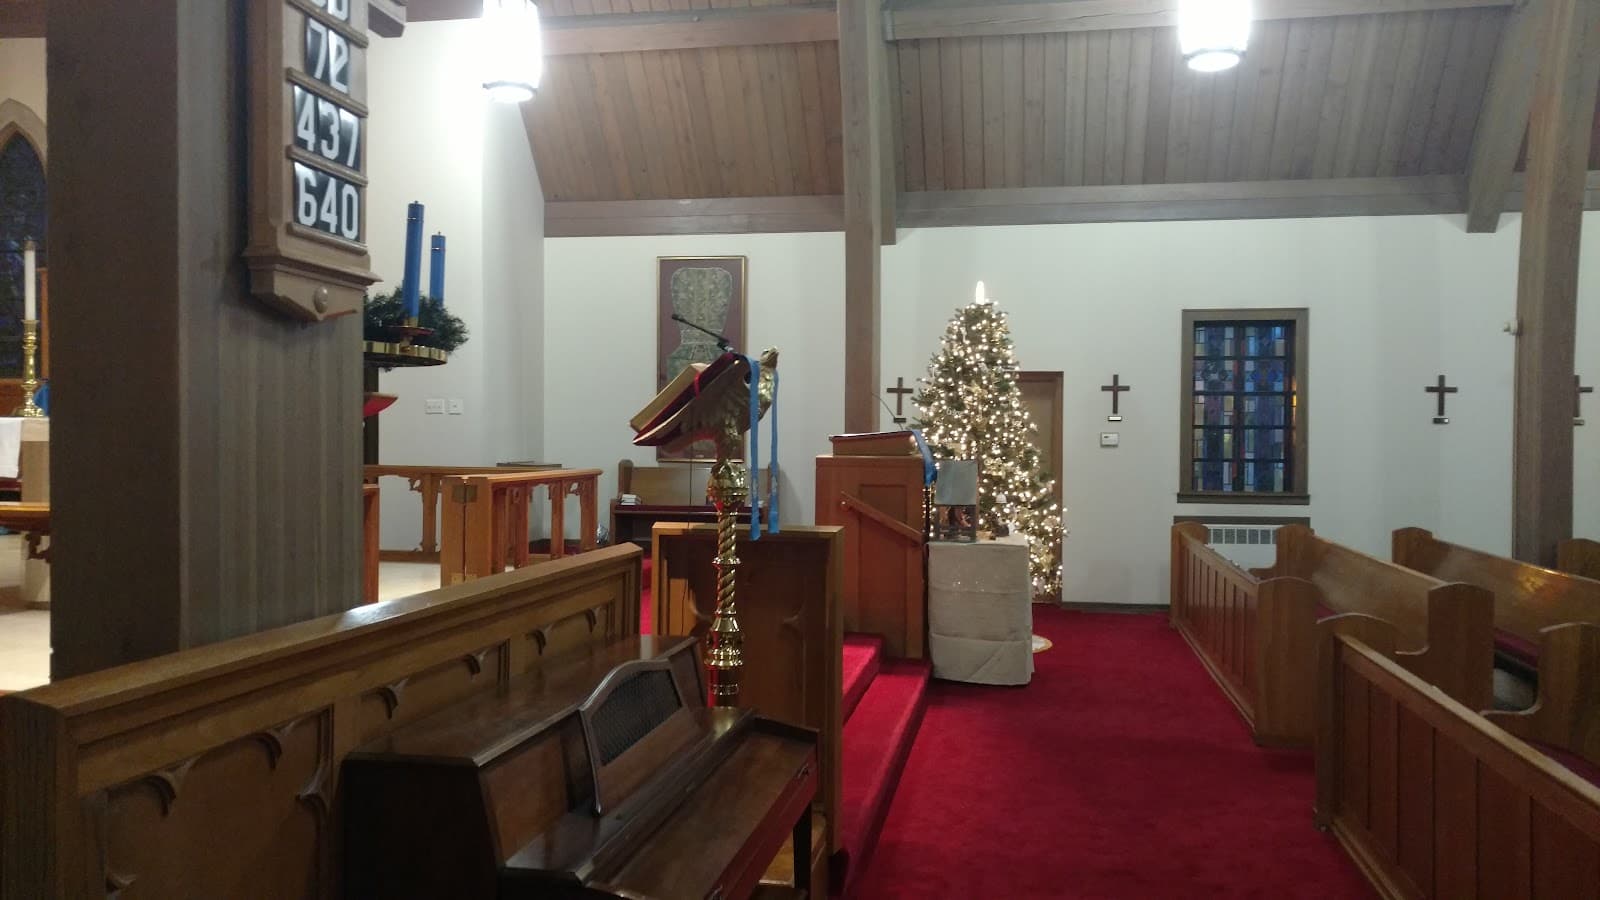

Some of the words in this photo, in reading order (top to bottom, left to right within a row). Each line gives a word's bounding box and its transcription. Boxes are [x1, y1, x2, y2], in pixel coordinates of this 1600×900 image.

[307, 17, 348, 93] 72
[297, 89, 360, 168] 437
[297, 167, 359, 240] 640
